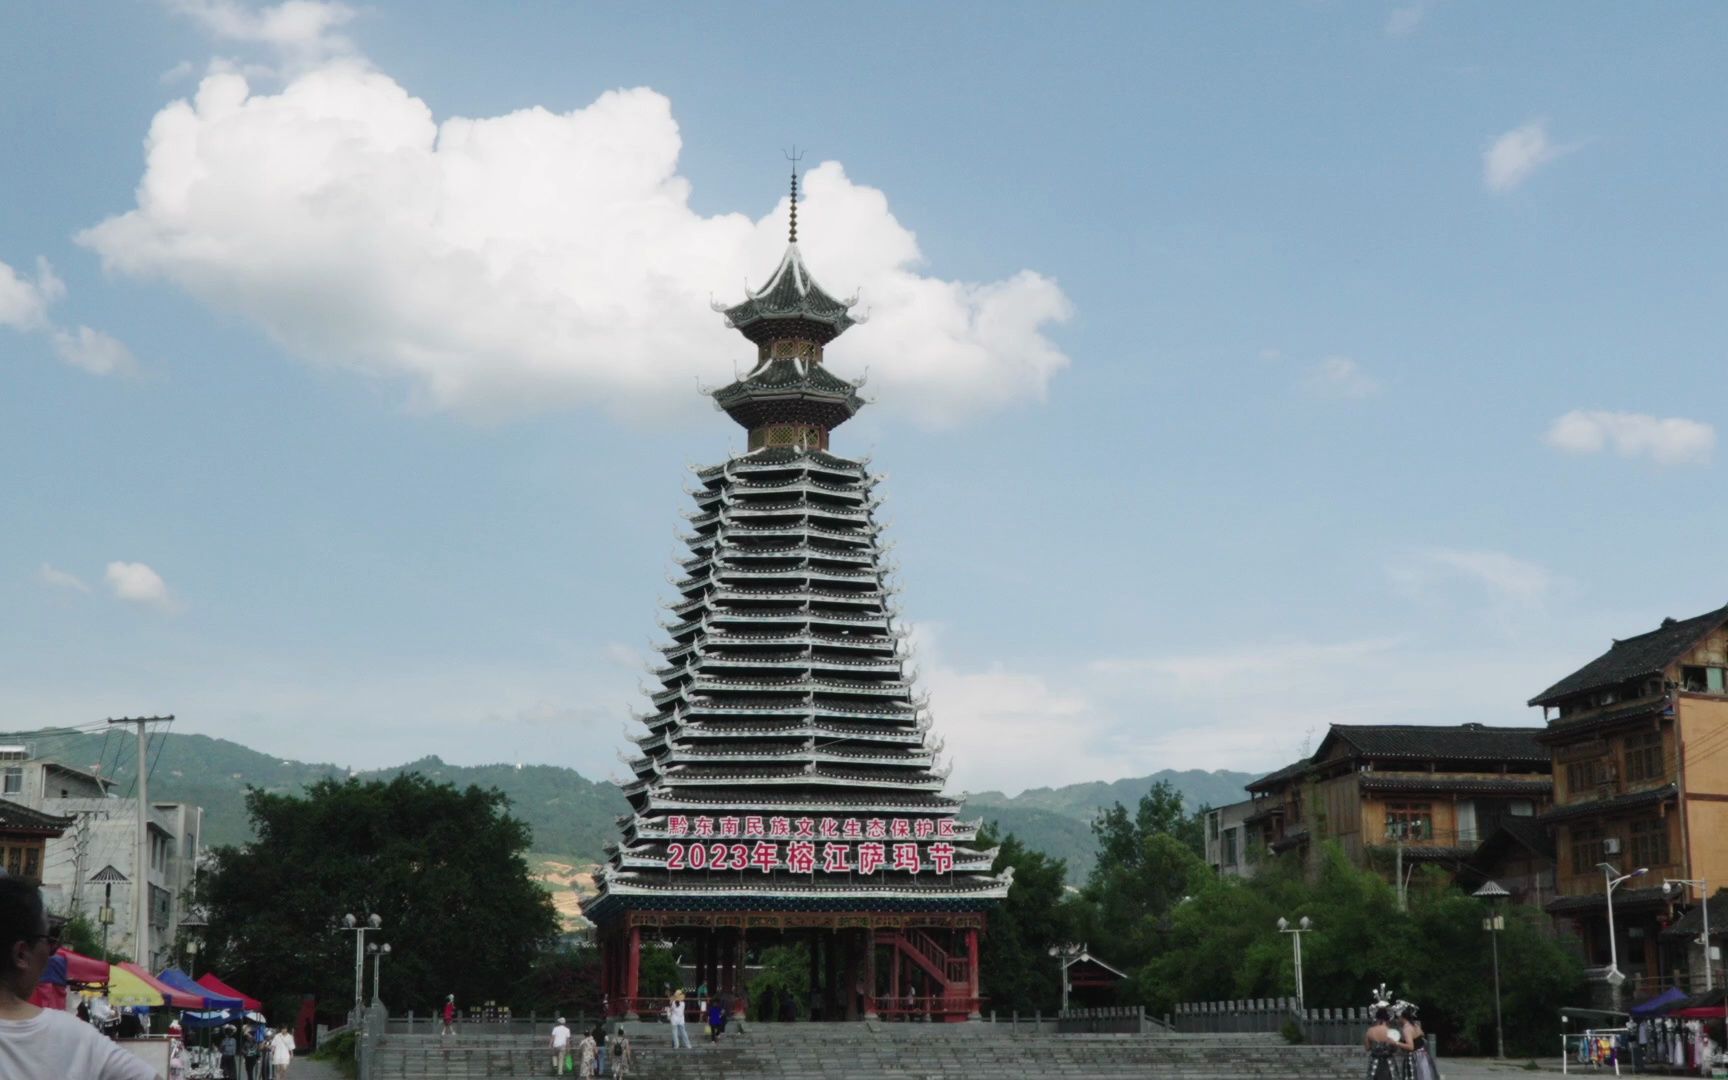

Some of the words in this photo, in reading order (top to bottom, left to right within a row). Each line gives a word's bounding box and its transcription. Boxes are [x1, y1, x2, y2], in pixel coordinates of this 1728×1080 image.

[667, 816, 956, 837] 黔东南民族文化生态保护区
[666, 841, 956, 875] 2023年榕江萨玛节
